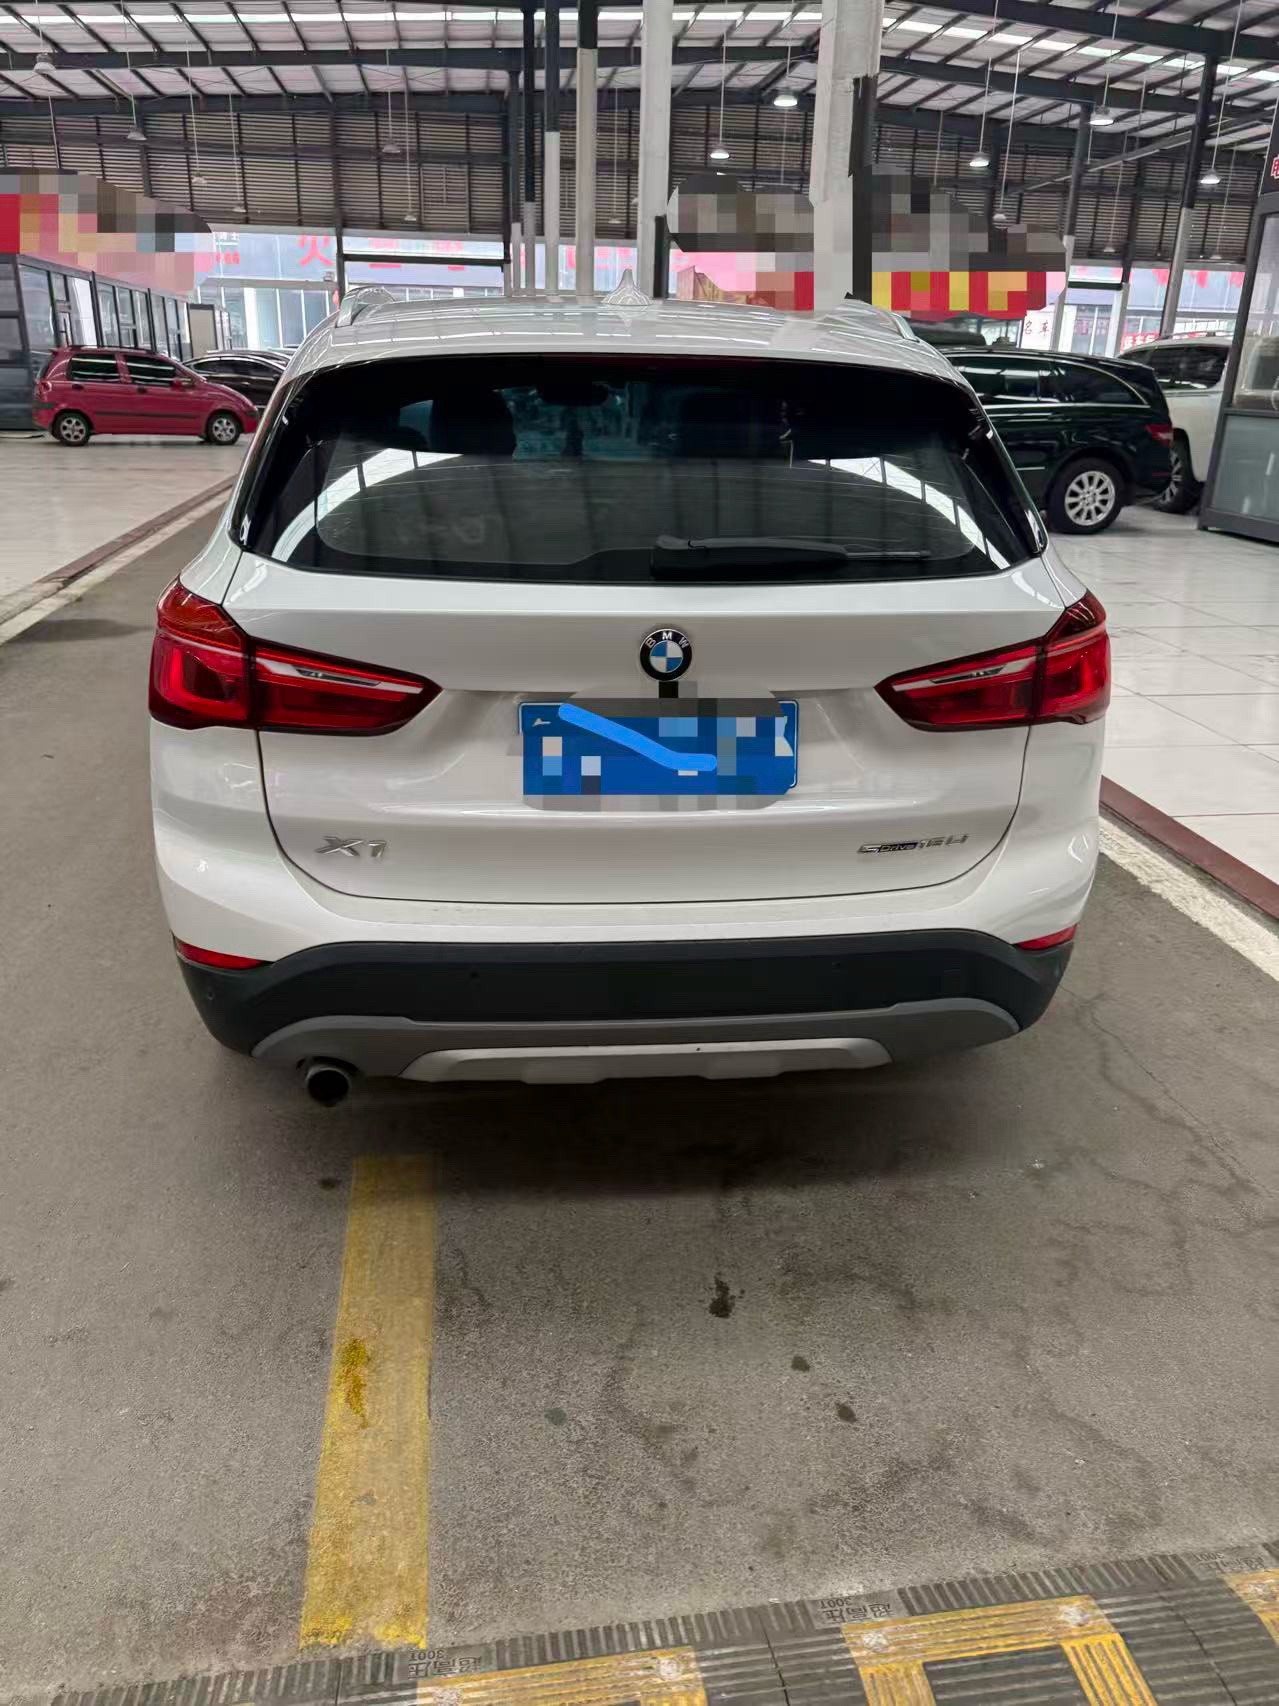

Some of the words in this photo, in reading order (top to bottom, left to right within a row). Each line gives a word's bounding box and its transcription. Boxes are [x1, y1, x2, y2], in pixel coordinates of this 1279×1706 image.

[298, 233, 335, 266] 火
[645, 632, 689, 648] BMW
[821, 1597, 852, 1609] 300T
[408, 1649, 445, 1661] 300T
